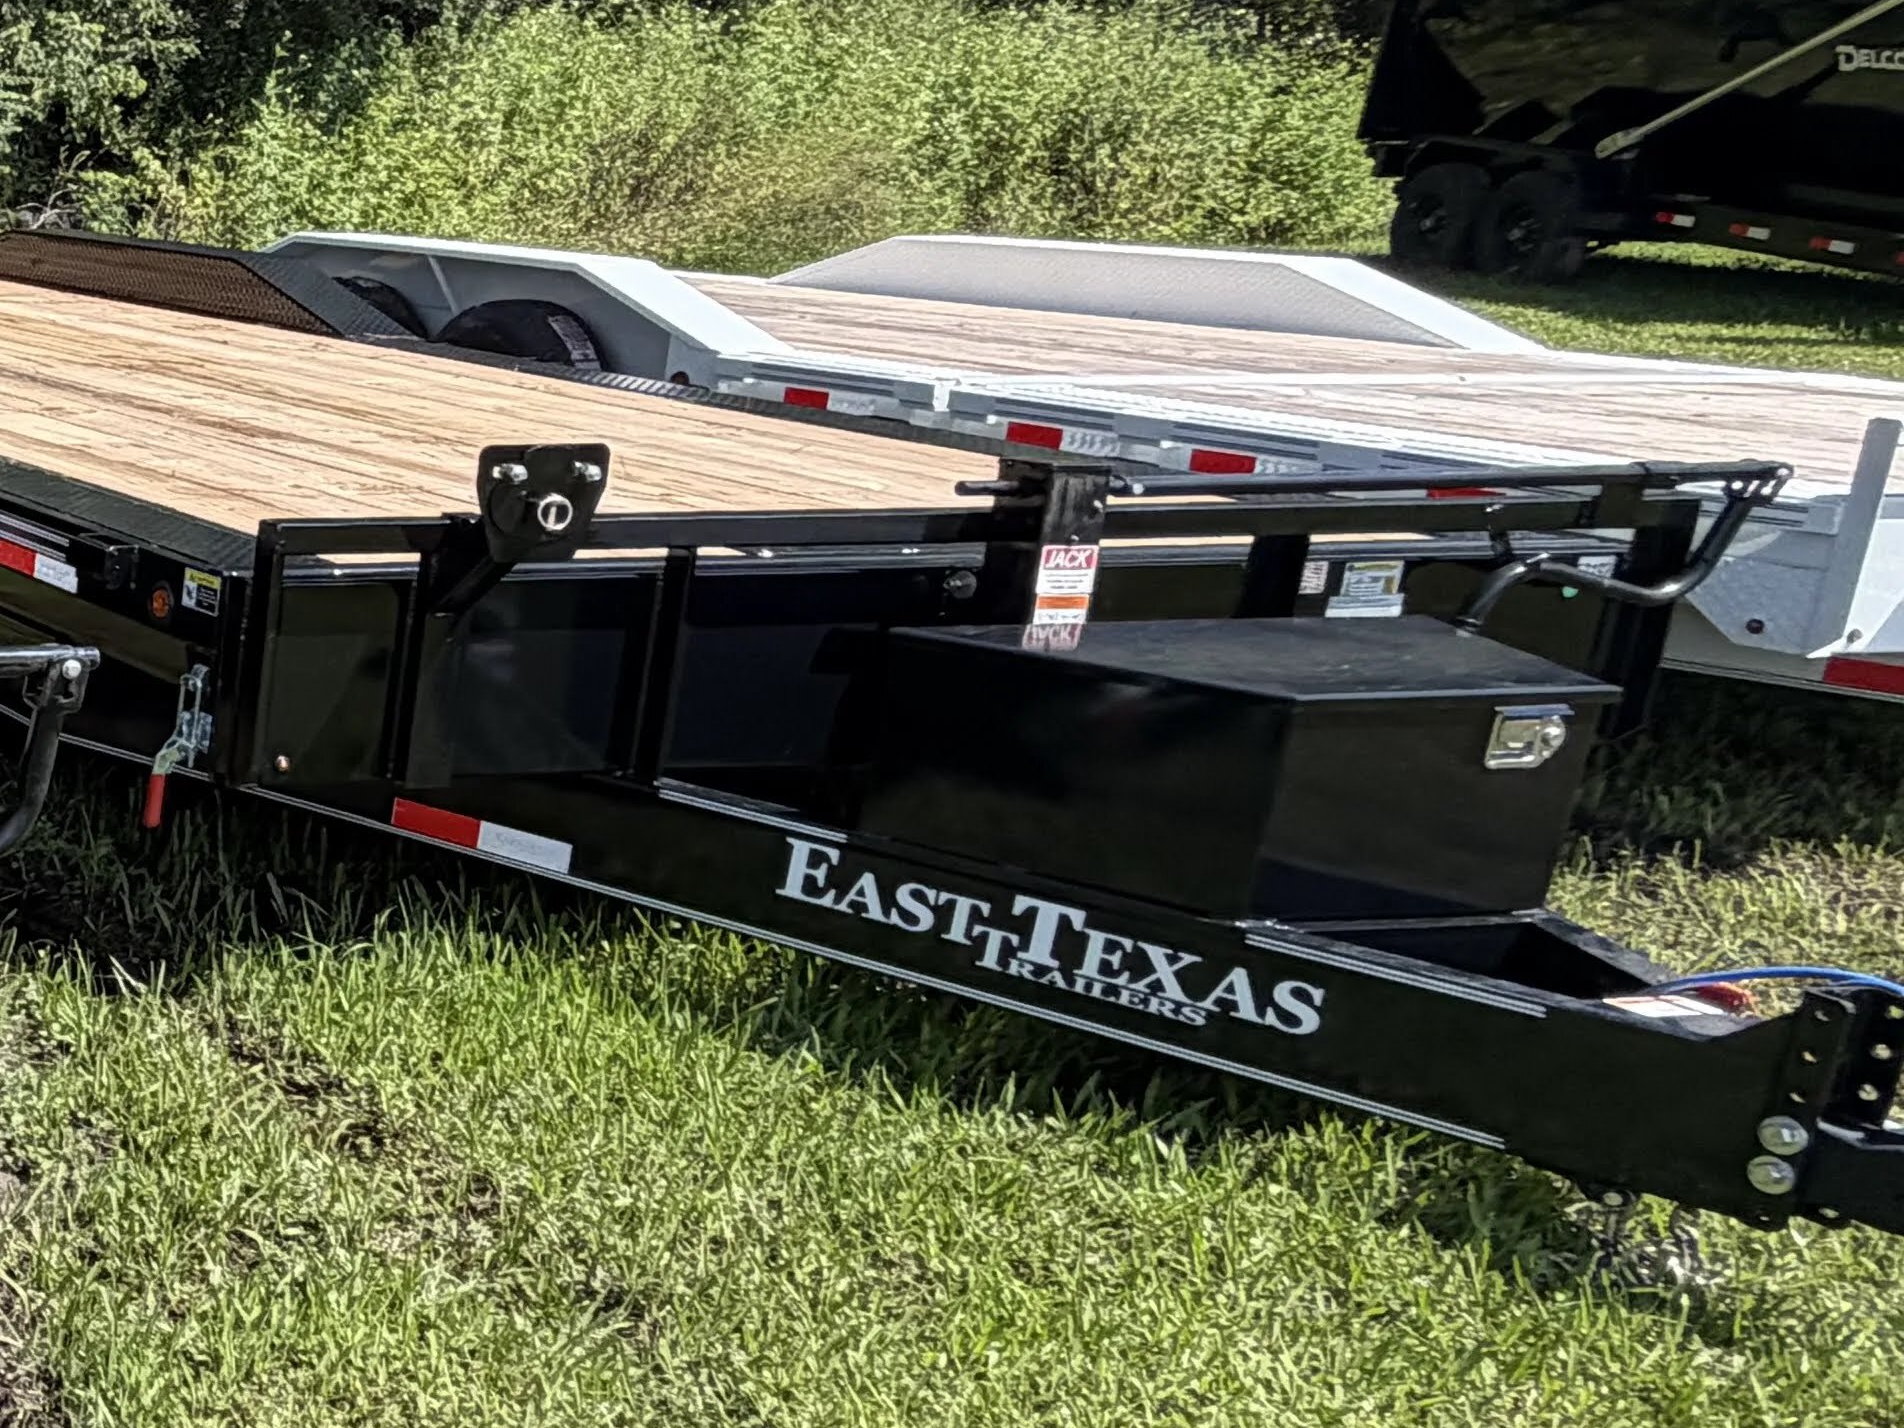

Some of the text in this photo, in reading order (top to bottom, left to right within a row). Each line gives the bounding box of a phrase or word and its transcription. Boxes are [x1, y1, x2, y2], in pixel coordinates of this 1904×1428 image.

[1044, 549, 1092, 569] JACK
[775, 836, 1327, 1036] EAST TEXAS
[971, 924, 1209, 1027] TRAILERS
